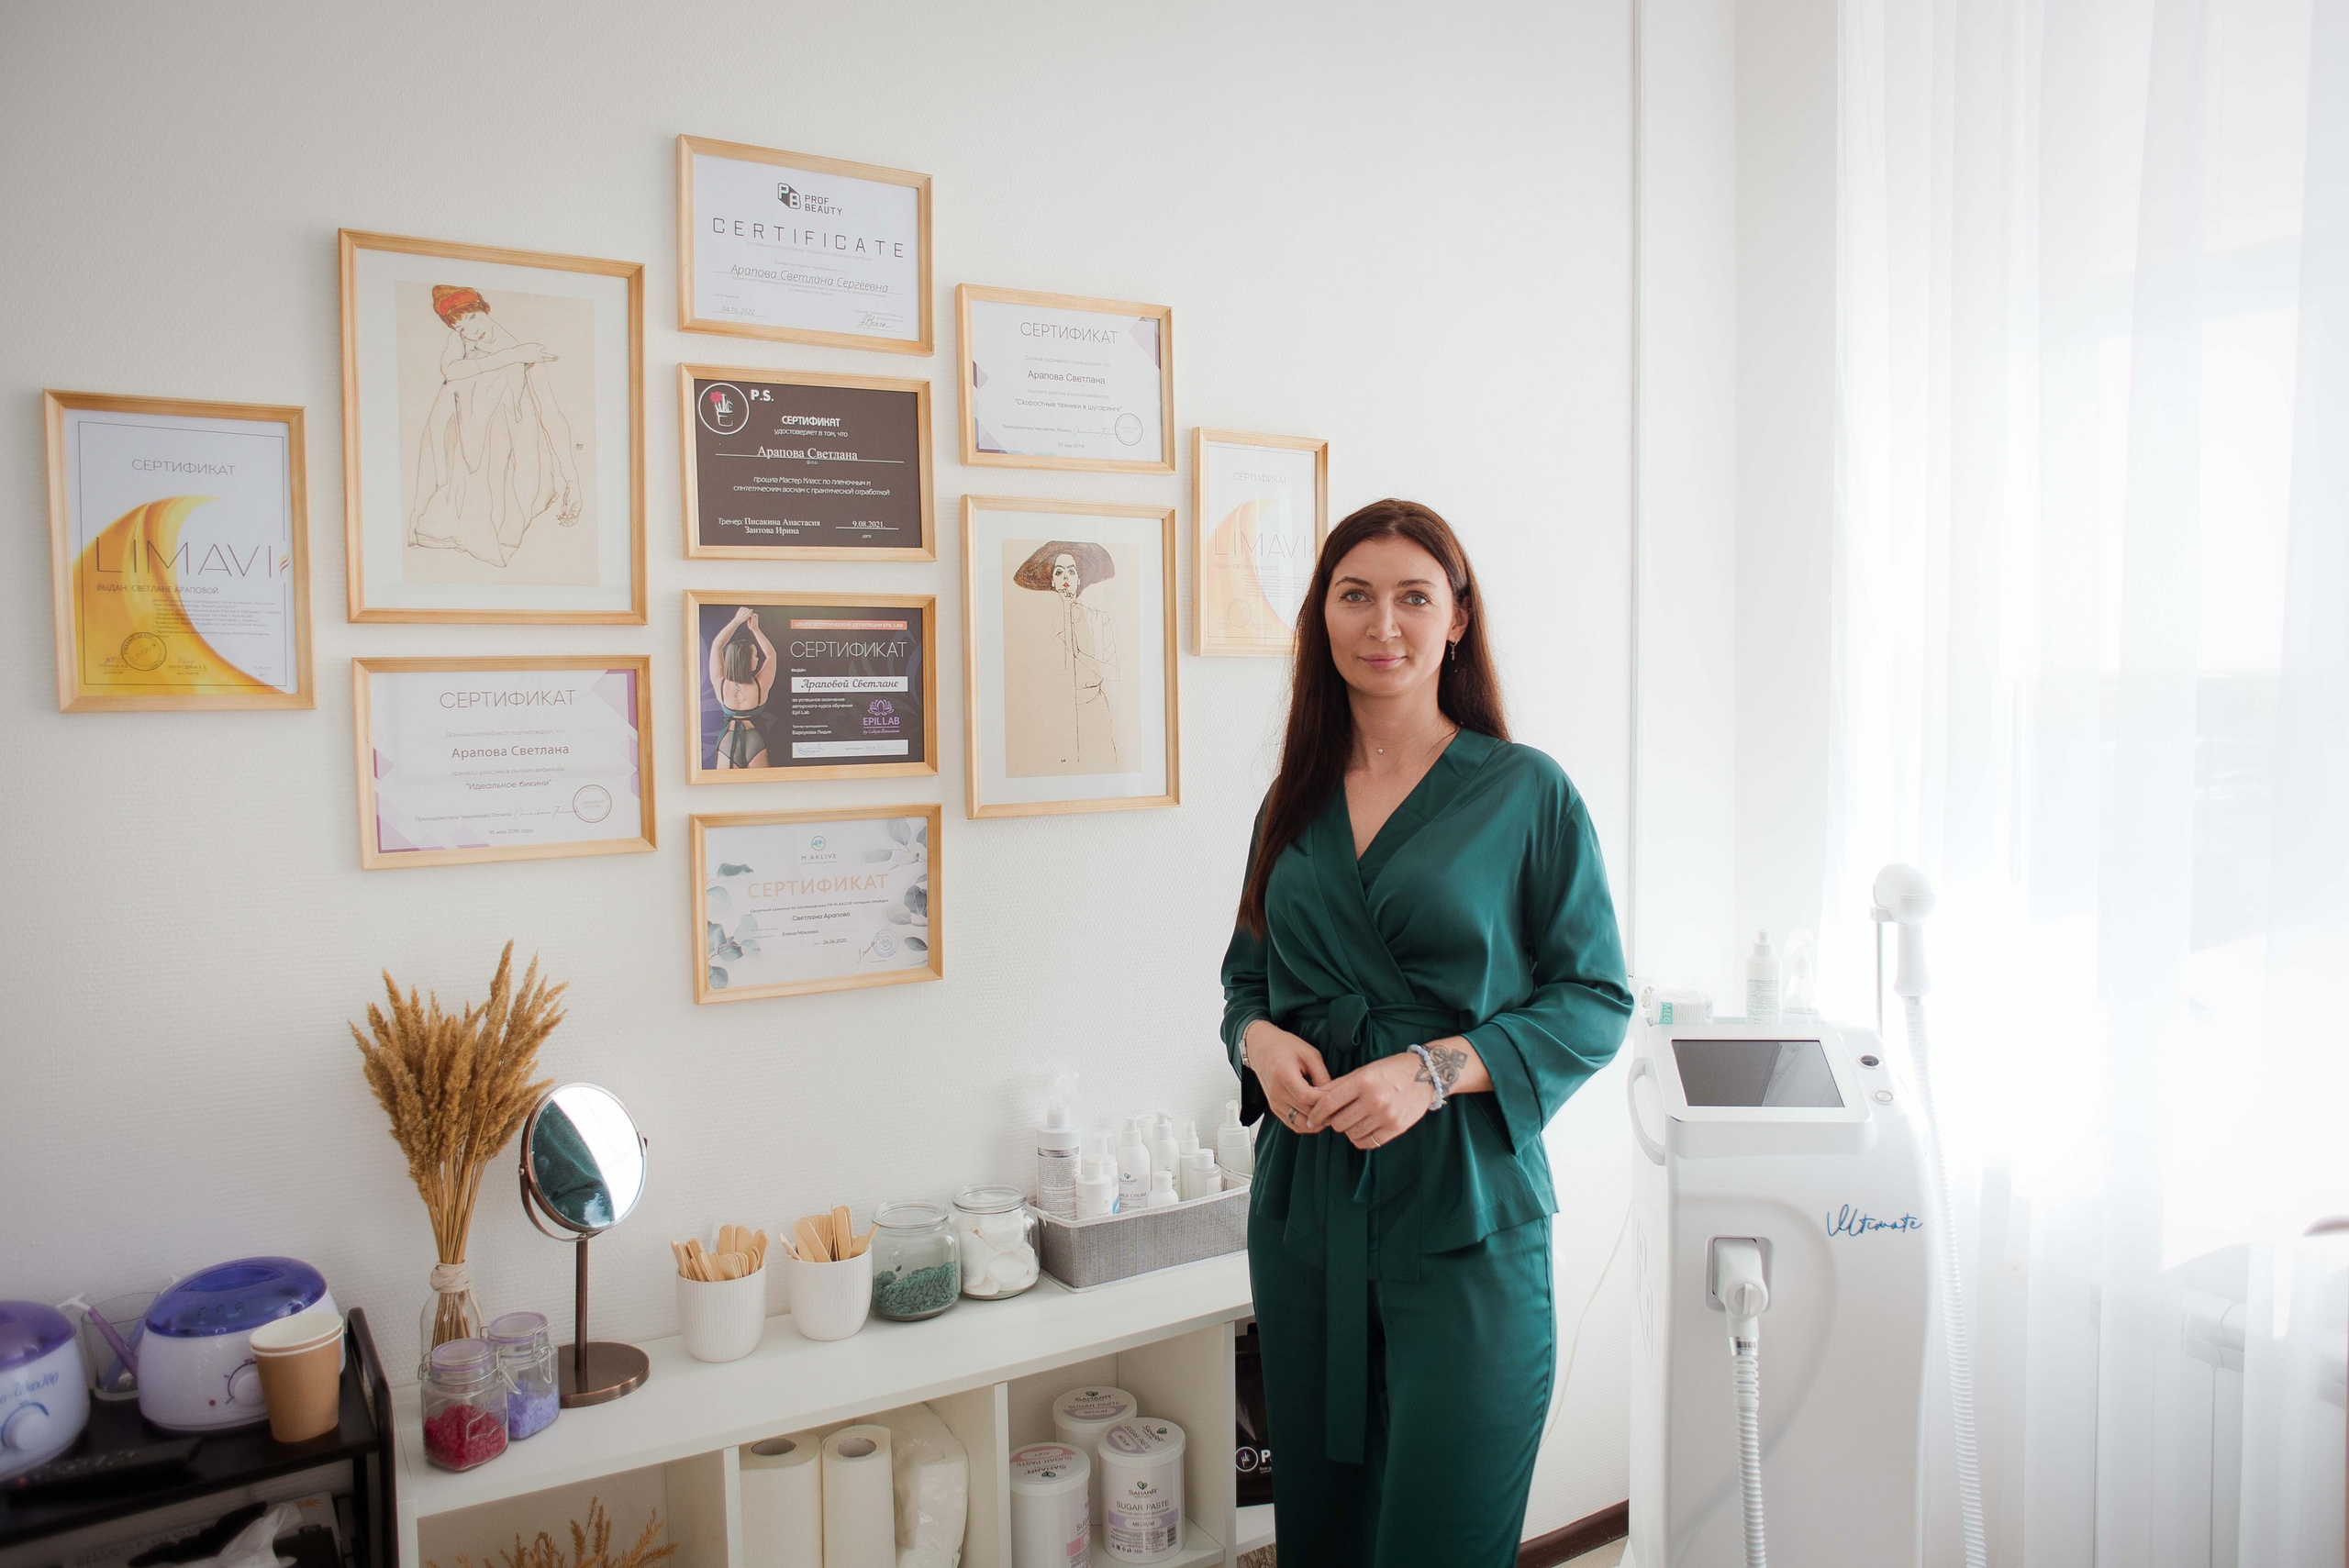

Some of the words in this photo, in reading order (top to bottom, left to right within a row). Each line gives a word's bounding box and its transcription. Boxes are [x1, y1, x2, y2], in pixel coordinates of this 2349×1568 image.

[805, 195, 829, 205] PROF
[805, 204, 843, 216] BEAUTY
[713, 217, 904, 258] CERTIFICATE
[730, 264, 777, 280] Арапова
[780, 270, 834, 286] Светлана
[837, 277, 888, 293] Сергеевна
[1020, 322, 1118, 344] СЕРТИФИКАТ
[1028, 370, 1064, 382] Арапова
[1065, 373, 1106, 384] Светлана
[751, 390, 774, 402] P.S.
[782, 416, 841, 428] СЕРТИФИКАТ
[774, 428, 818, 438] удостоверяет
[757, 446, 805, 460] Арапова
[807, 448, 859, 461] Светлана
[131, 458, 237, 476] СЕРТИФИКАТ
[753, 476, 778, 484] прошла
[779, 477, 802, 485] Мастер
[1233, 472, 1288, 485] СЕРТИФИКАТ
[733, 485, 782, 494] синтетическим
[718, 517, 744, 527] Тренер:
[782, 517, 821, 528] Анастасия
[775, 527, 800, 537] Ирина
[1215, 528, 1307, 560] LIMAVI
[96, 537, 272, 578] LIMAVI
[97, 584, 129, 592] ВЫДАН:
[131, 584, 173, 594] СВЕТЛАНЕ
[174, 586, 219, 595] АРАПОВОЙ
[790, 640, 908, 658] СЕРТИФИКАТ
[801, 678, 850, 692] Араповой
[852, 678, 899, 689] Светлане
[440, 689, 577, 710] СЕРТИФИКАТ
[473, 730, 509, 739] сертификат
[451, 747, 508, 761] Арапова
[511, 745, 570, 757] Светлана
[465, 781, 518, 792] "Идеальное
[519, 779, 552, 788] бикини"
[801, 853, 837, 862] M.AKLIVE
[748, 873, 888, 899] СЕРТИФИКАТ
[792, 913, 823, 921] Светлана
[823, 911, 851, 920] Арапова
[1826, 1203, 1923, 1237] Ultimate
[1116, 1500, 1143, 1511] SUGAR
[1146, 1498, 1169, 1511] PASTE
